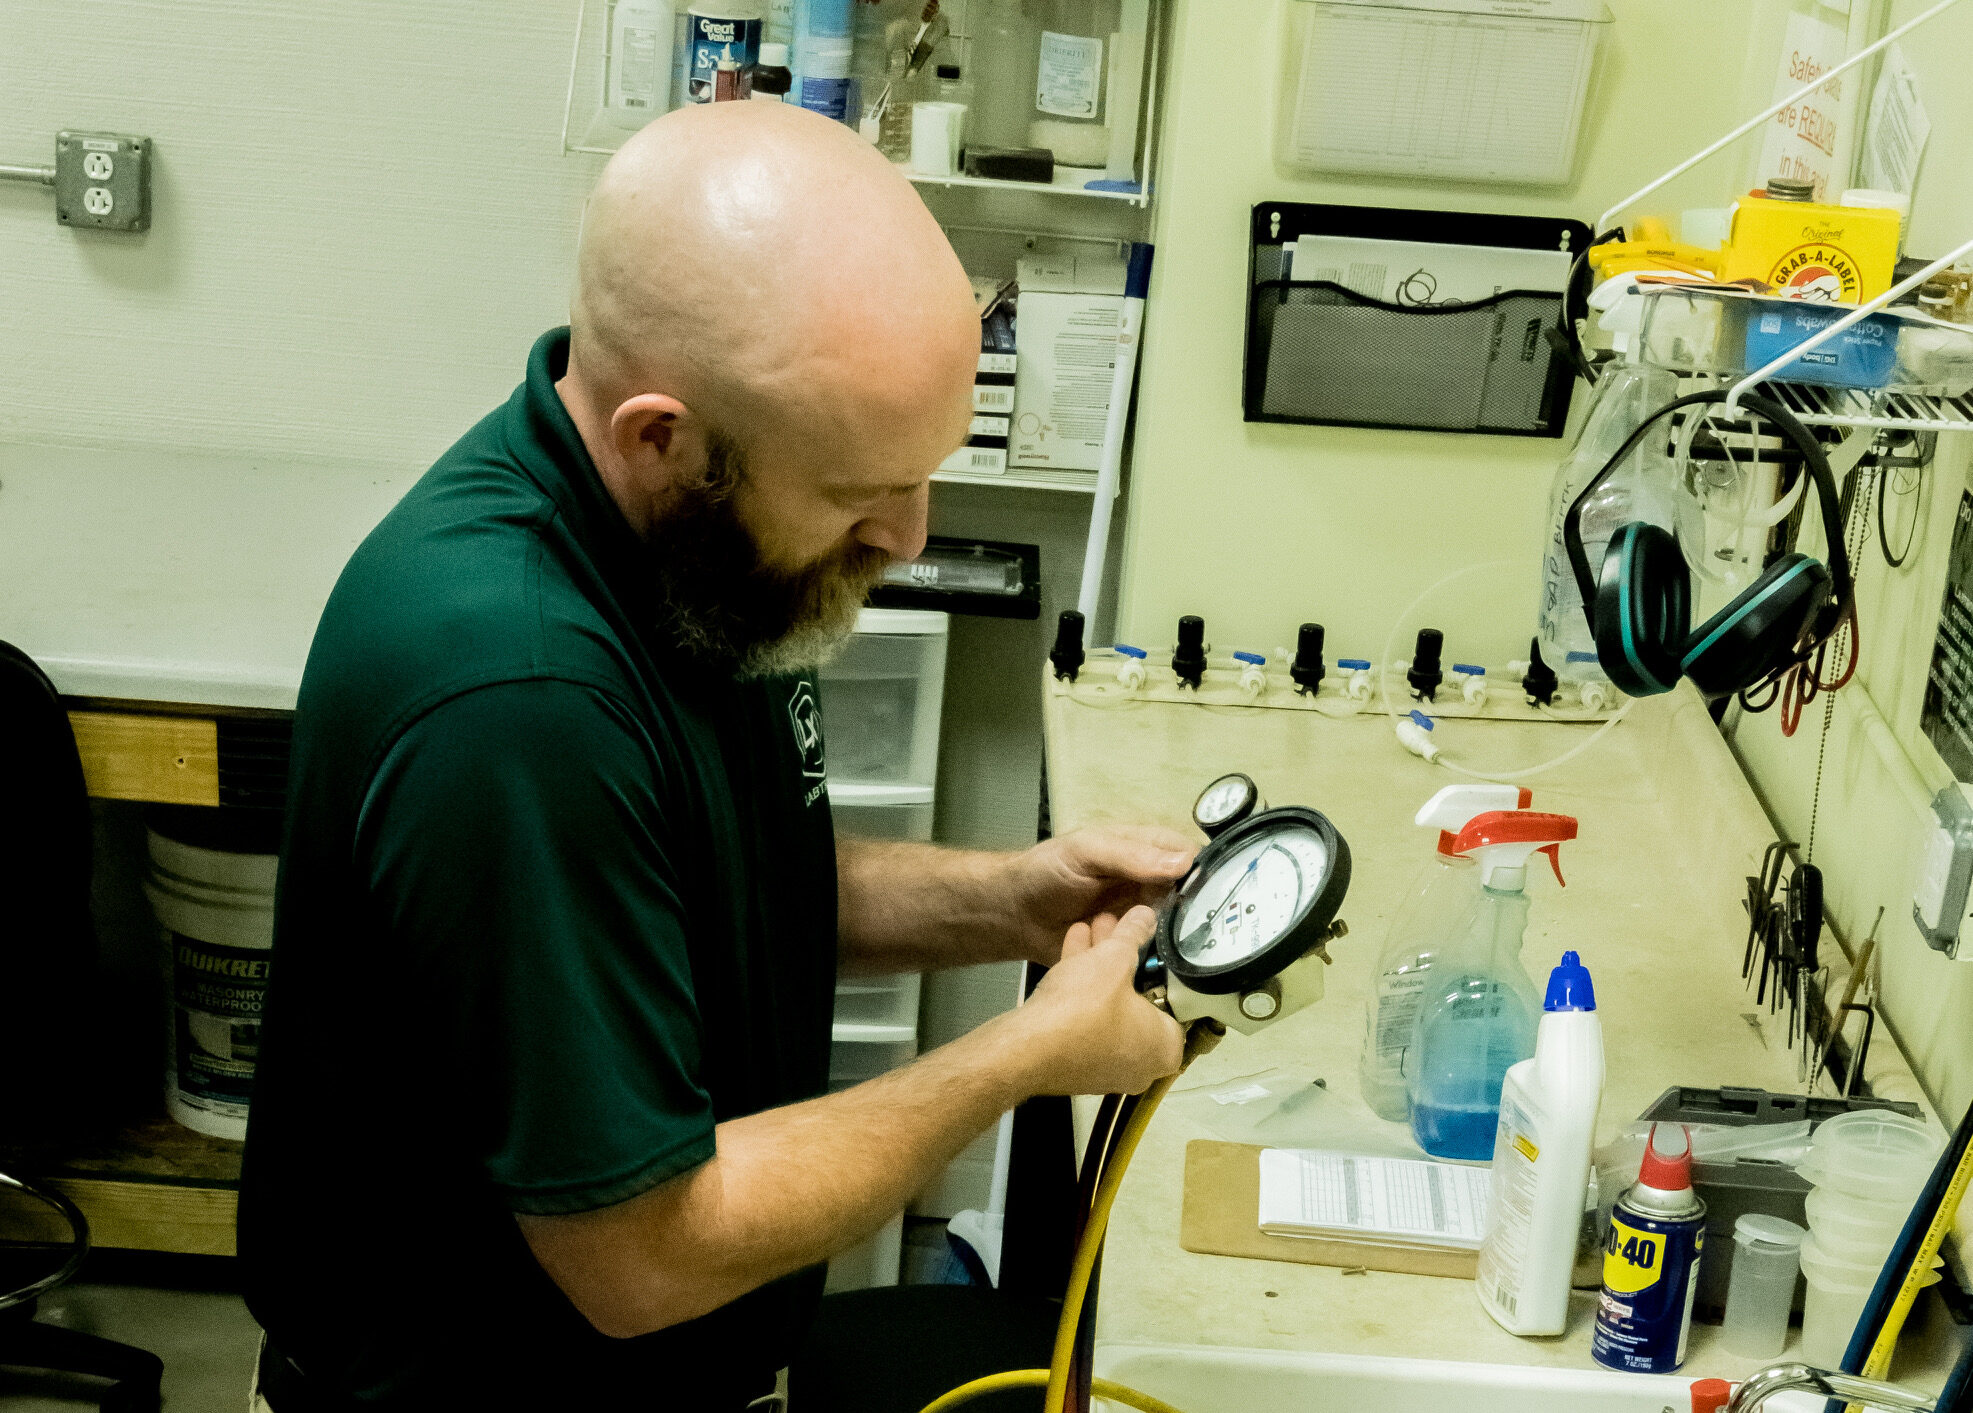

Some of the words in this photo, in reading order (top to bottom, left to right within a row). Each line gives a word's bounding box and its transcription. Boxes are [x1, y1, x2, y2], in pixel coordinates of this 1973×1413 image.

[701, 19, 735, 35] Great
[708, 32, 735, 43] Value
[1778, 105, 1796, 128] are
[1779, 148, 1791, 177] in
[1802, 226, 1844, 241] Original
[1775, 250, 1855, 292] GRAB-A-LABEL
[1849, 322, 1884, 338] Cotto
[1844, 336, 1861, 345] Stick
[1803, 354, 1820, 363] body
[1825, 356, 1836, 364] DG
[197, 982, 265, 1001] MASONRY
